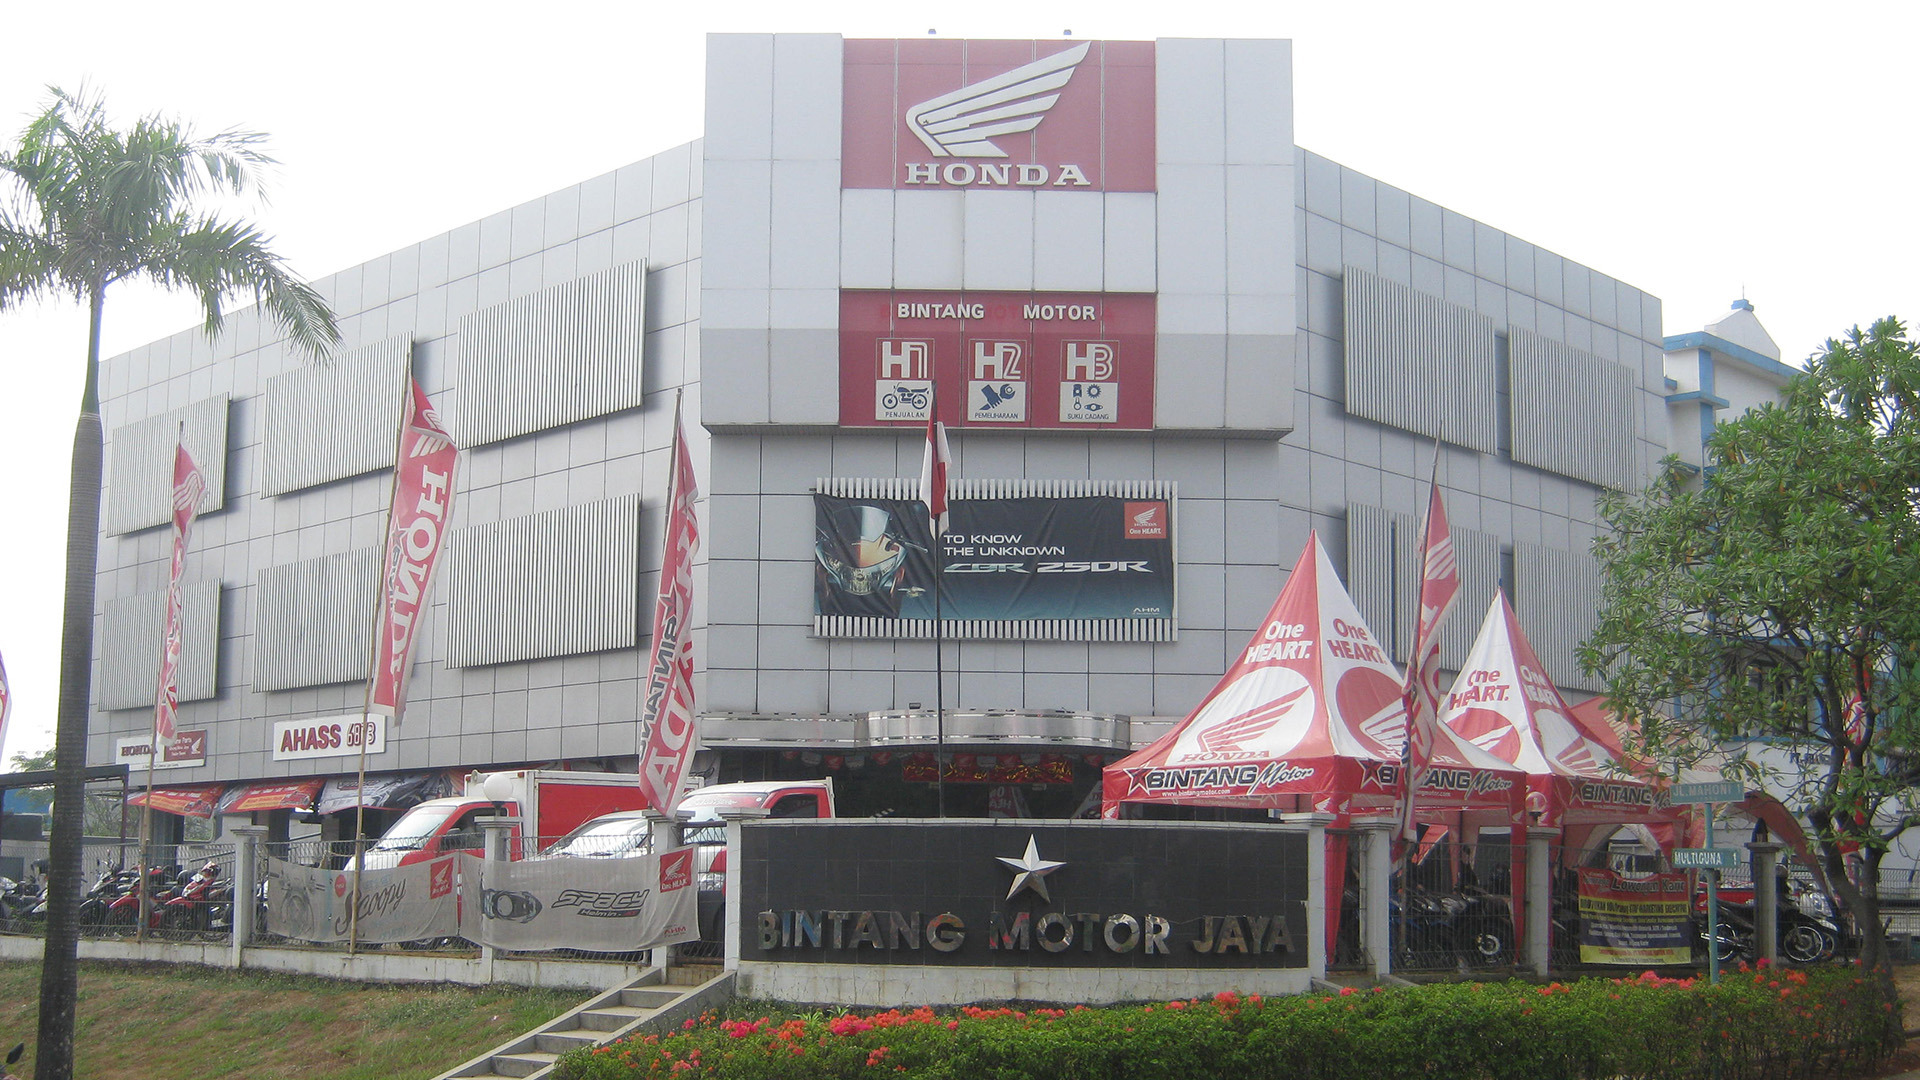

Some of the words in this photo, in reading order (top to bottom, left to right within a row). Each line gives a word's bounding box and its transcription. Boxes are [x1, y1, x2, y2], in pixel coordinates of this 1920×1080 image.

[905, 163, 1091, 186] HONDA
[897, 303, 985, 319] BINTANG
[1023, 304, 1096, 320] MOTOR
[882, 341, 928, 379] H1
[975, 342, 1022, 380] H2
[1067, 343, 1114, 381] H3
[943, 534, 966, 544] TO
[970, 534, 1022, 544] KNOW
[943, 547, 976, 556] THE
[979, 547, 1065, 556] UNKNOWN
[943, 563, 1031, 574] CBR
[1264, 620, 1305, 642] One
[1333, 618, 1367, 641] One
[1244, 641, 1313, 665] HEART.
[1326, 639, 1388, 666] HEART.
[280, 724, 341, 752] AHASS
[1178, 750, 1271, 763] HONDA
[1146, 765, 1260, 790] BINTANG
[1247, 761, 1314, 795] Motor
[1464, 770, 1513, 801] Motor
[1162, 789, 1231, 797] www.bintangmotor.com
[1581, 784, 1652, 806] BINTANG
[1674, 851, 1722, 865] MULTIGUNA
[1732, 852, 1737, 866] 1
[335, 878, 406, 936] Scoopy
[757, 911, 965, 953] BINTANG
[988, 911, 1172, 954] MOTOR
[1192, 914, 1295, 954] JAYA
